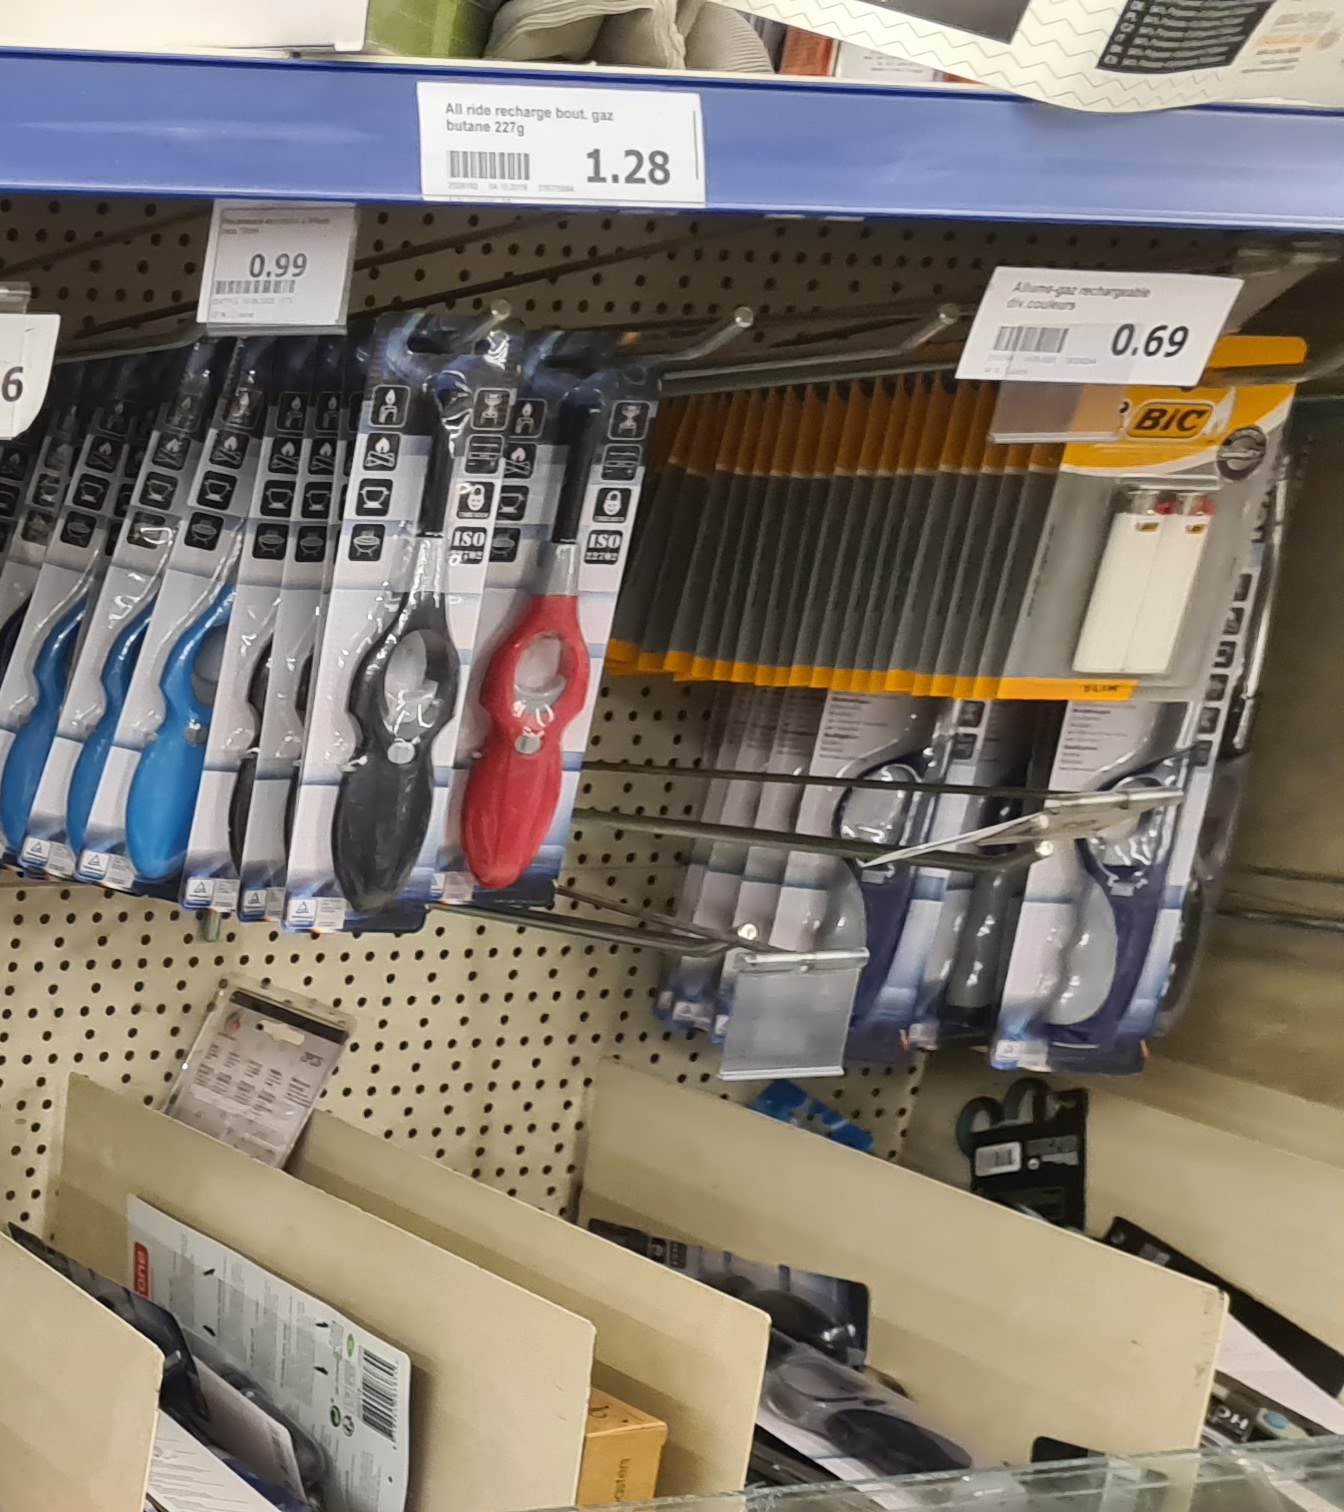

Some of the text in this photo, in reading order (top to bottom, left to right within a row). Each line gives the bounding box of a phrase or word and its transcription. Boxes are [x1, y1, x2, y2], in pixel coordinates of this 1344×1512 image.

[445, 102, 614, 123] All ride recharge gaz
[446, 119, 525, 136] butane 227g
[586, 148, 671, 186] 1.28
[249, 253, 307, 278] 0.99
[1013, 282, 1078, 297] Allume-gaz
[1111, 324, 1189, 358] 0.69
[1134, 408, 1207, 432] BIC
[453, 531, 485, 547] ISO
[589, 533, 621, 548] ISO
